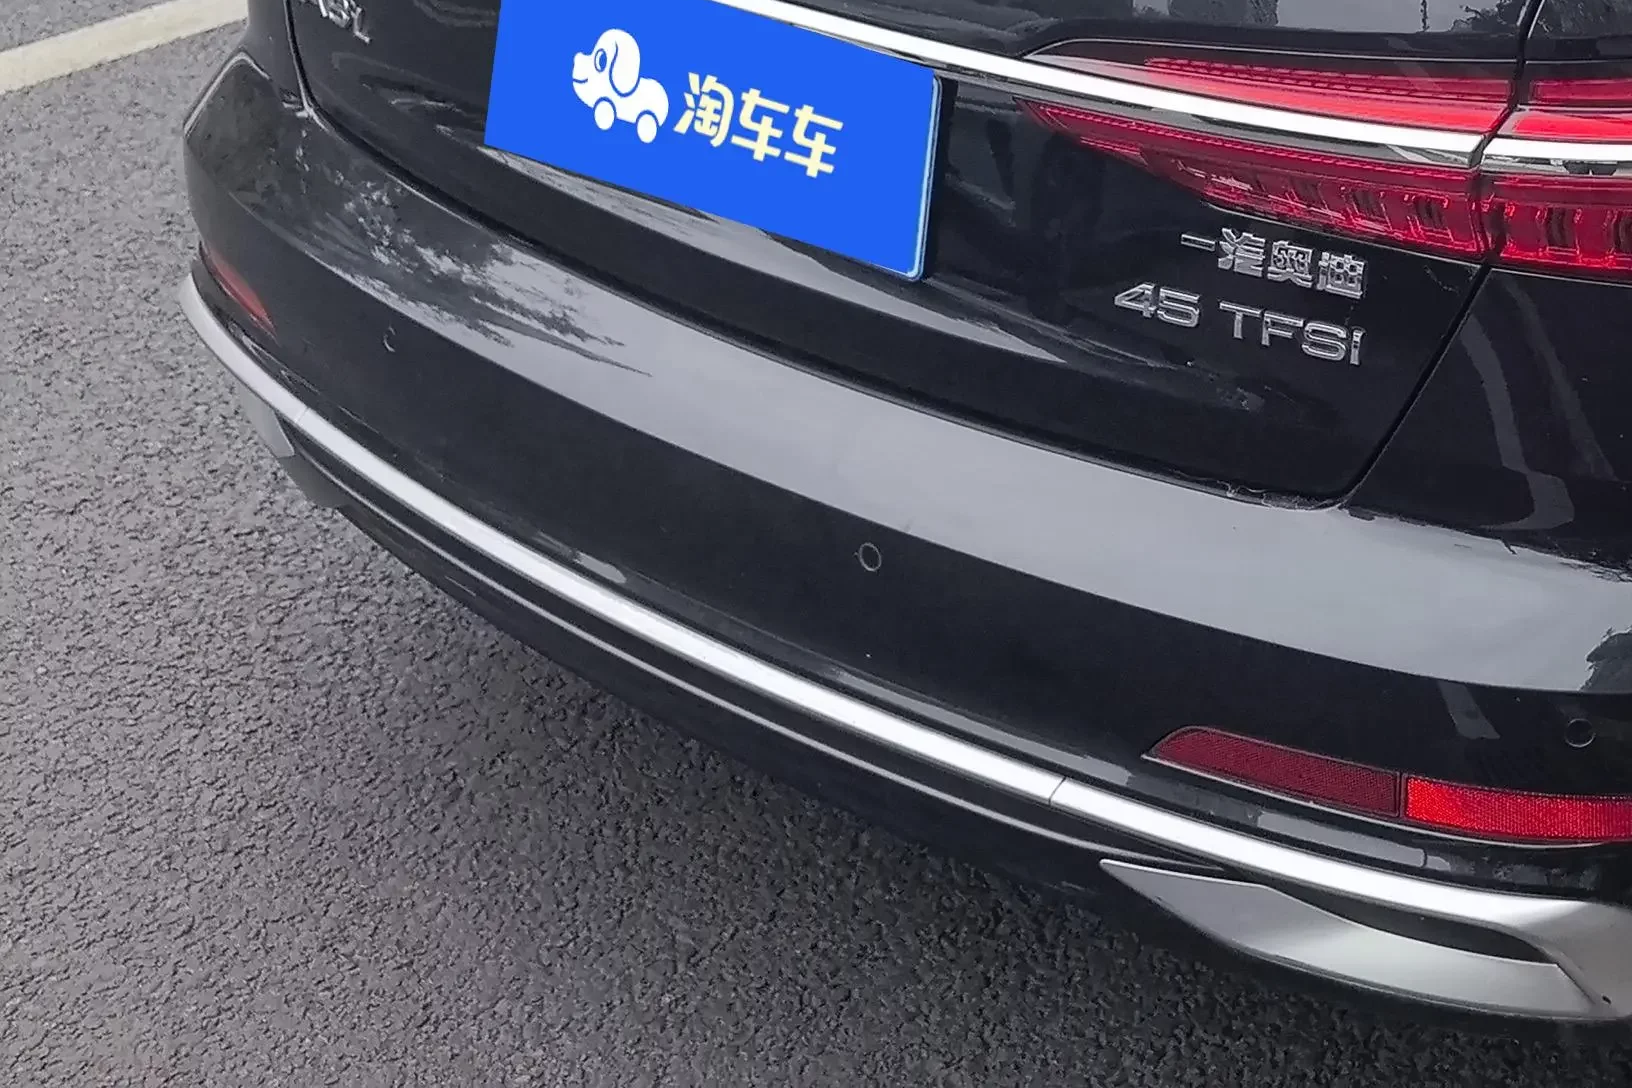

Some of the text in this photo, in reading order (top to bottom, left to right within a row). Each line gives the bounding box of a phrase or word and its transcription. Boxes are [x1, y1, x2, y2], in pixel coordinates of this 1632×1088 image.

[1181, 227, 1366, 299] 一汽奥迪
[1114, 280, 1201, 329] 45
